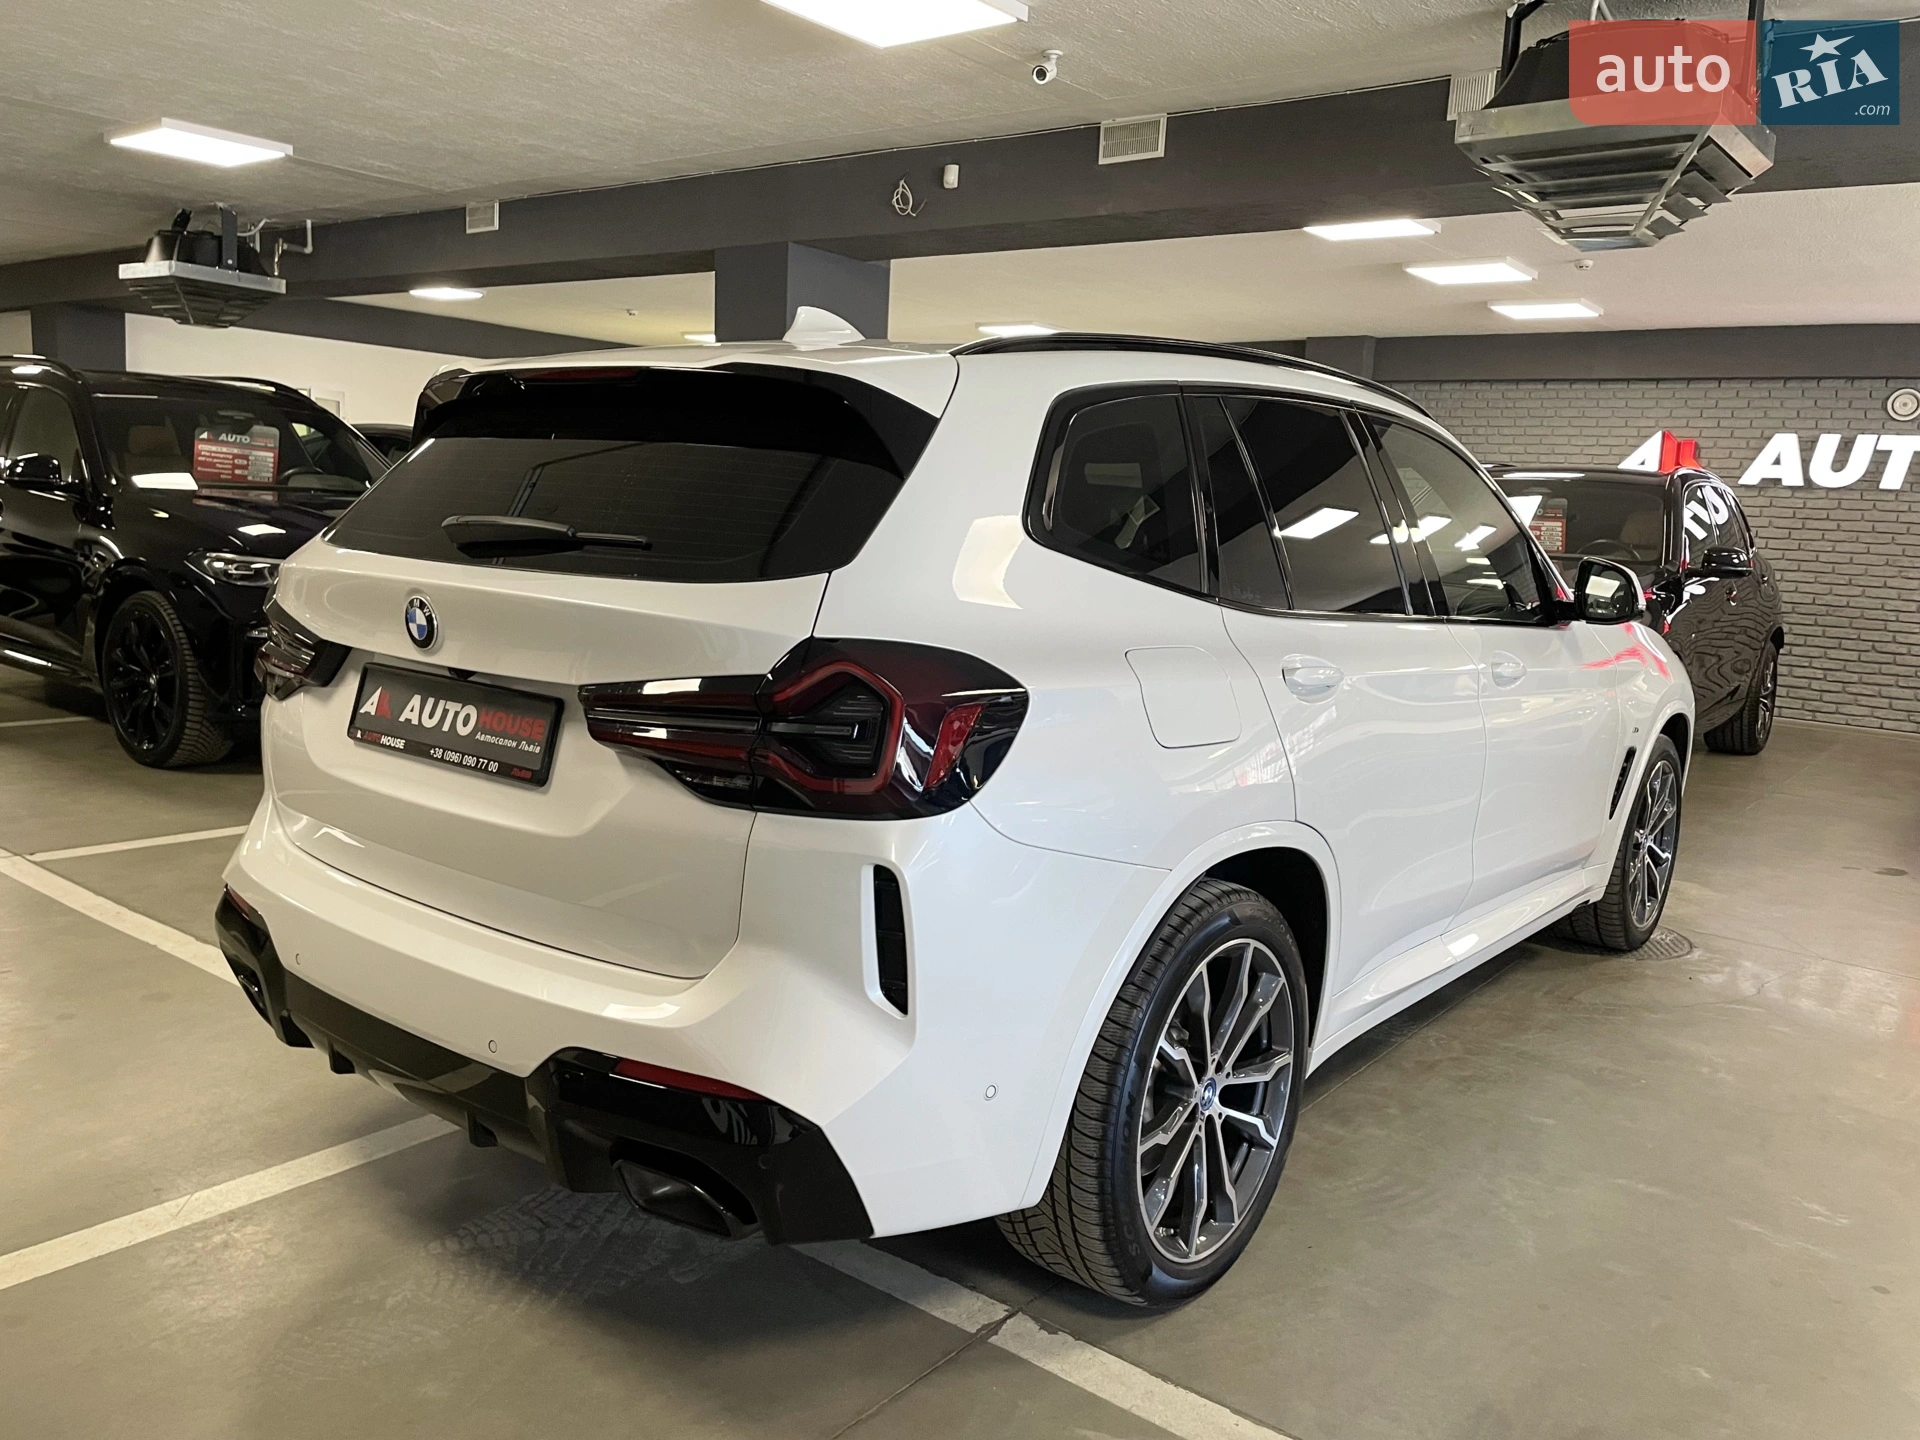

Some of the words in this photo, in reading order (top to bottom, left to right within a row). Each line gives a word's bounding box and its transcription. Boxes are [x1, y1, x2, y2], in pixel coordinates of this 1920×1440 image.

[219, 433, 251, 443] AUTO
[1737, 432, 1920, 490] AUT
[399, 694, 478, 736] AUTO
[479, 708, 545, 741] HOUSE
[380, 734, 406, 749] HOUSE
[474, 731, 518, 749] Автосалон
[518, 741, 541, 754] Львів
[429, 747, 443, 759] +38
[443, 750, 462, 763] (096)
[462, 754, 477, 767] 090
[477, 758, 488, 770] 77
[488, 760, 499, 773] 00
